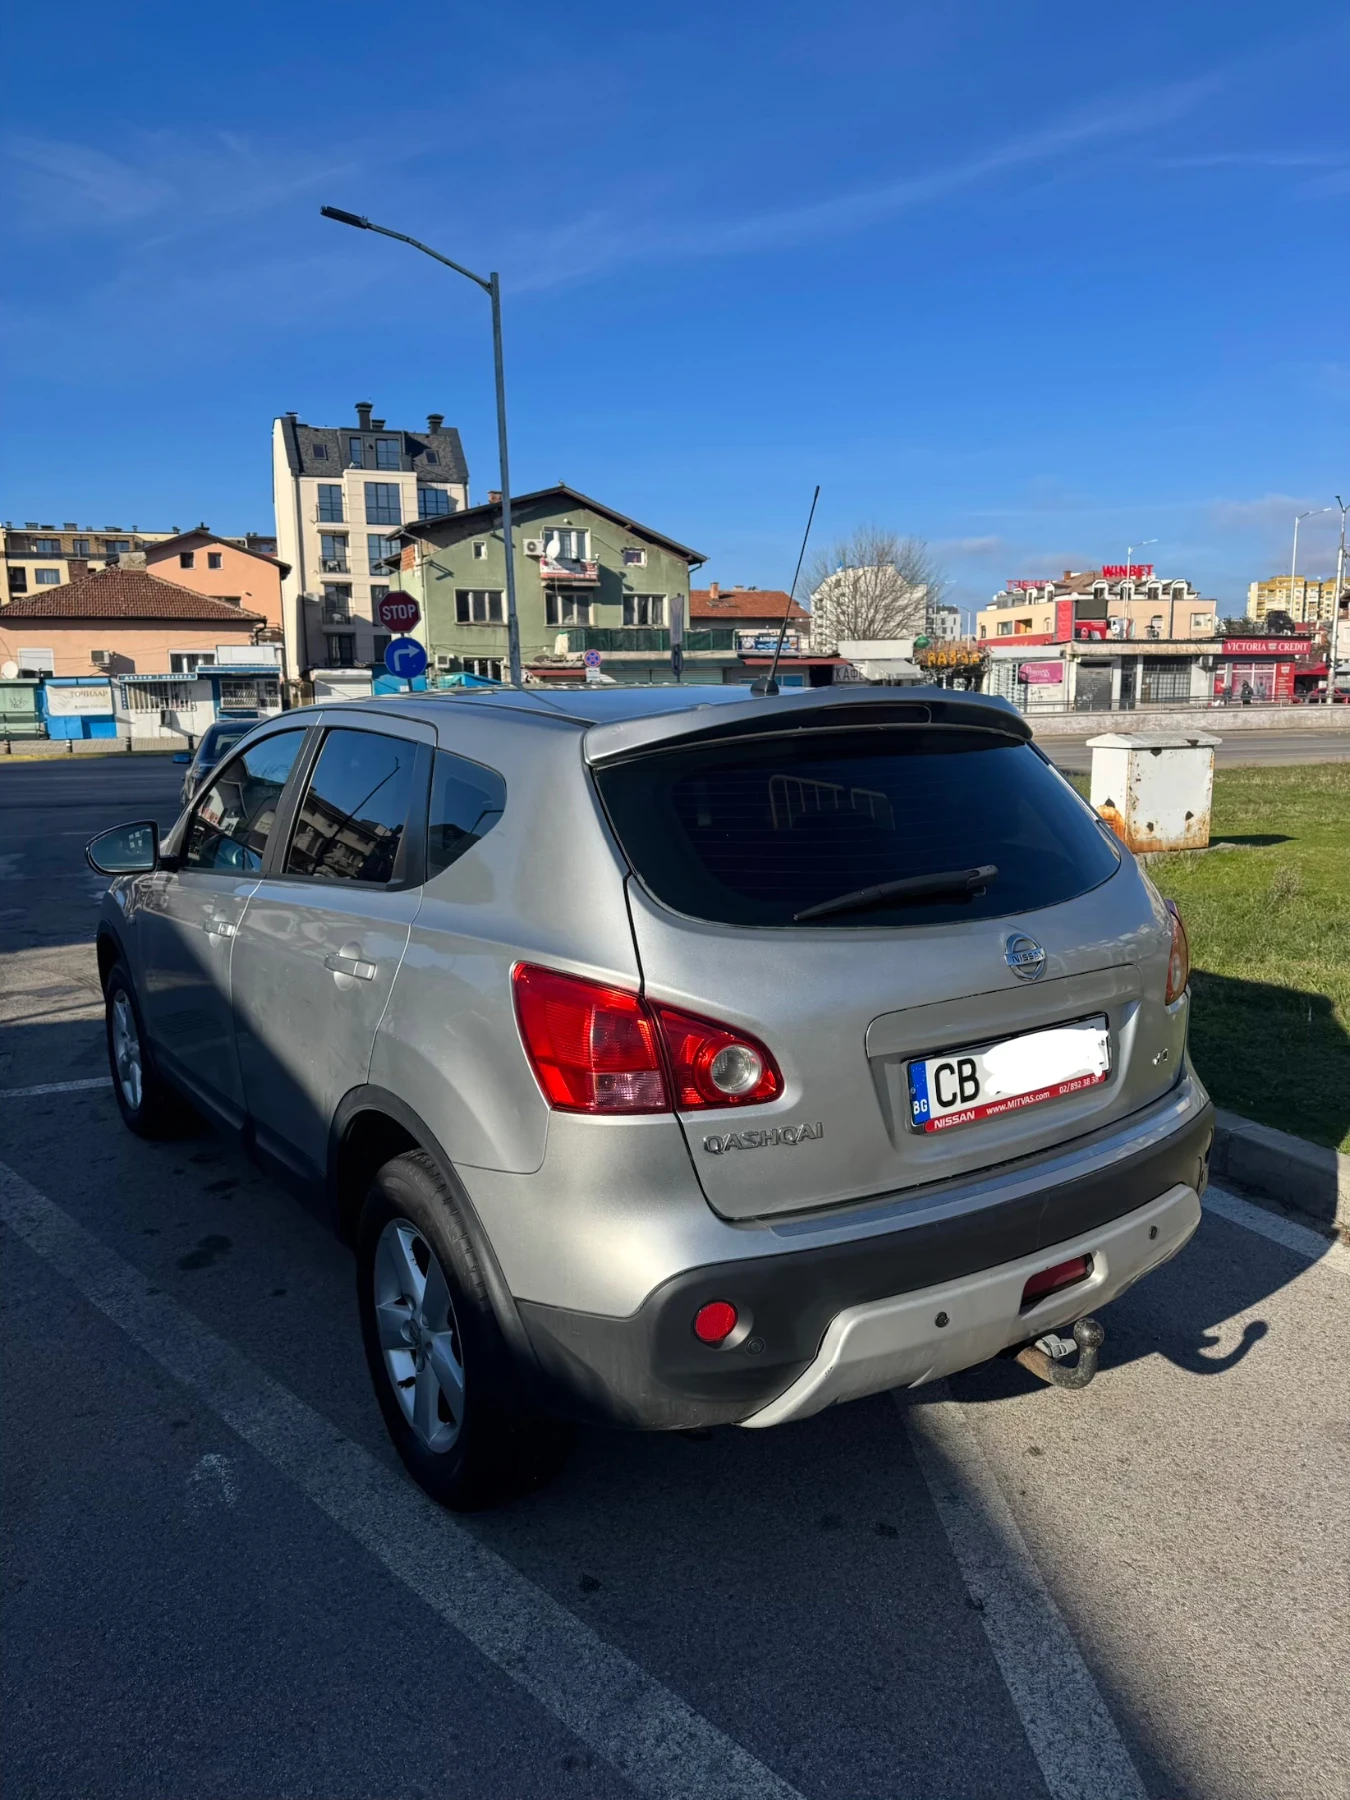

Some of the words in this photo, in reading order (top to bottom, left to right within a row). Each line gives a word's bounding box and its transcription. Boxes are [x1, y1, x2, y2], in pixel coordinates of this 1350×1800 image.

[1102, 565, 1154, 578] WINBET
[382, 604, 416, 620] STOP
[1227, 642, 1267, 651] VICTORIA
[1278, 642, 1308, 651] CREDIT
[1011, 950, 1044, 963] NISSAN
[913, 1099, 928, 1115] BG
[934, 1110, 975, 1129] NISSAN
[986, 1091, 1050, 1115] www.MITVAS.com
[1083, 1077, 1091, 1087] 38
[703, 1121, 825, 1155] QASHQAI
